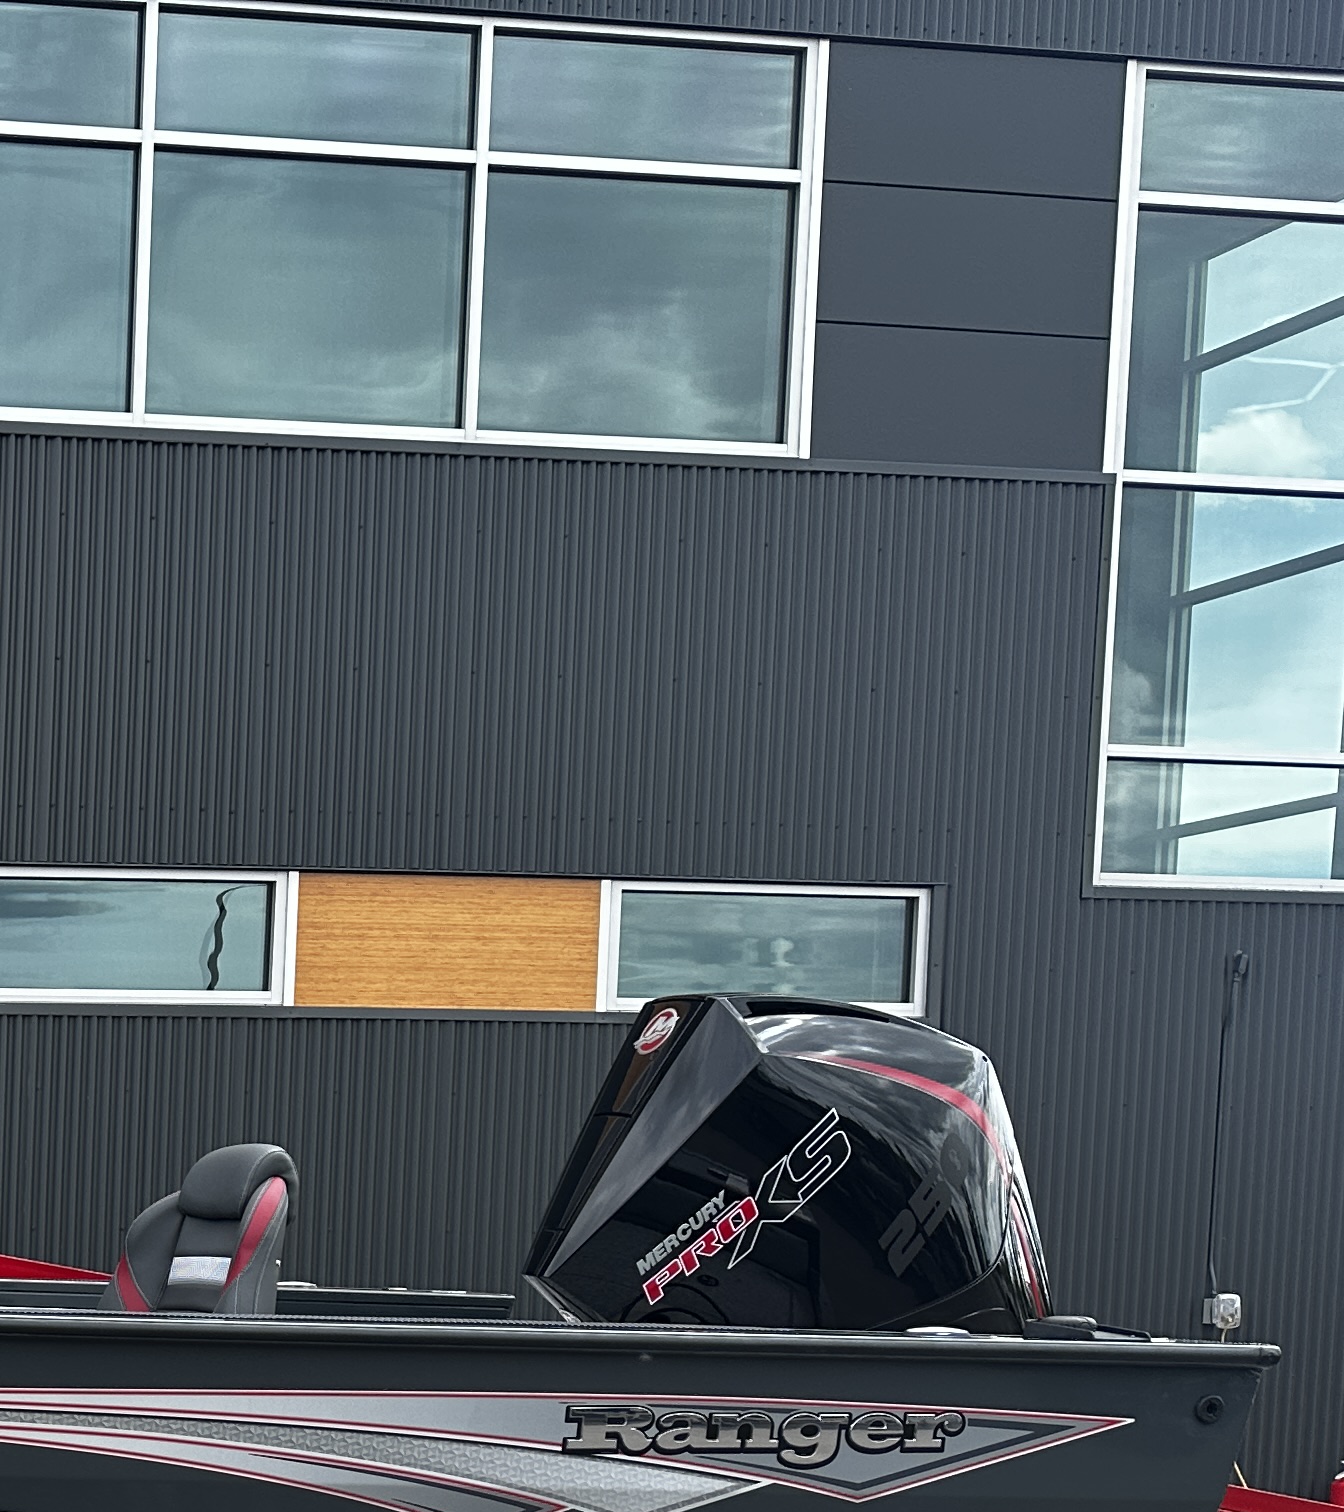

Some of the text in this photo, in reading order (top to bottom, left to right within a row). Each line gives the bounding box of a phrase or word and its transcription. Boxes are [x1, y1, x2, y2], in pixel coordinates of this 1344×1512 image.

[636, 1190, 730, 1276] MERCURY
[877, 1133, 972, 1278] 250
[564, 1405, 966, 1468] Ranger
